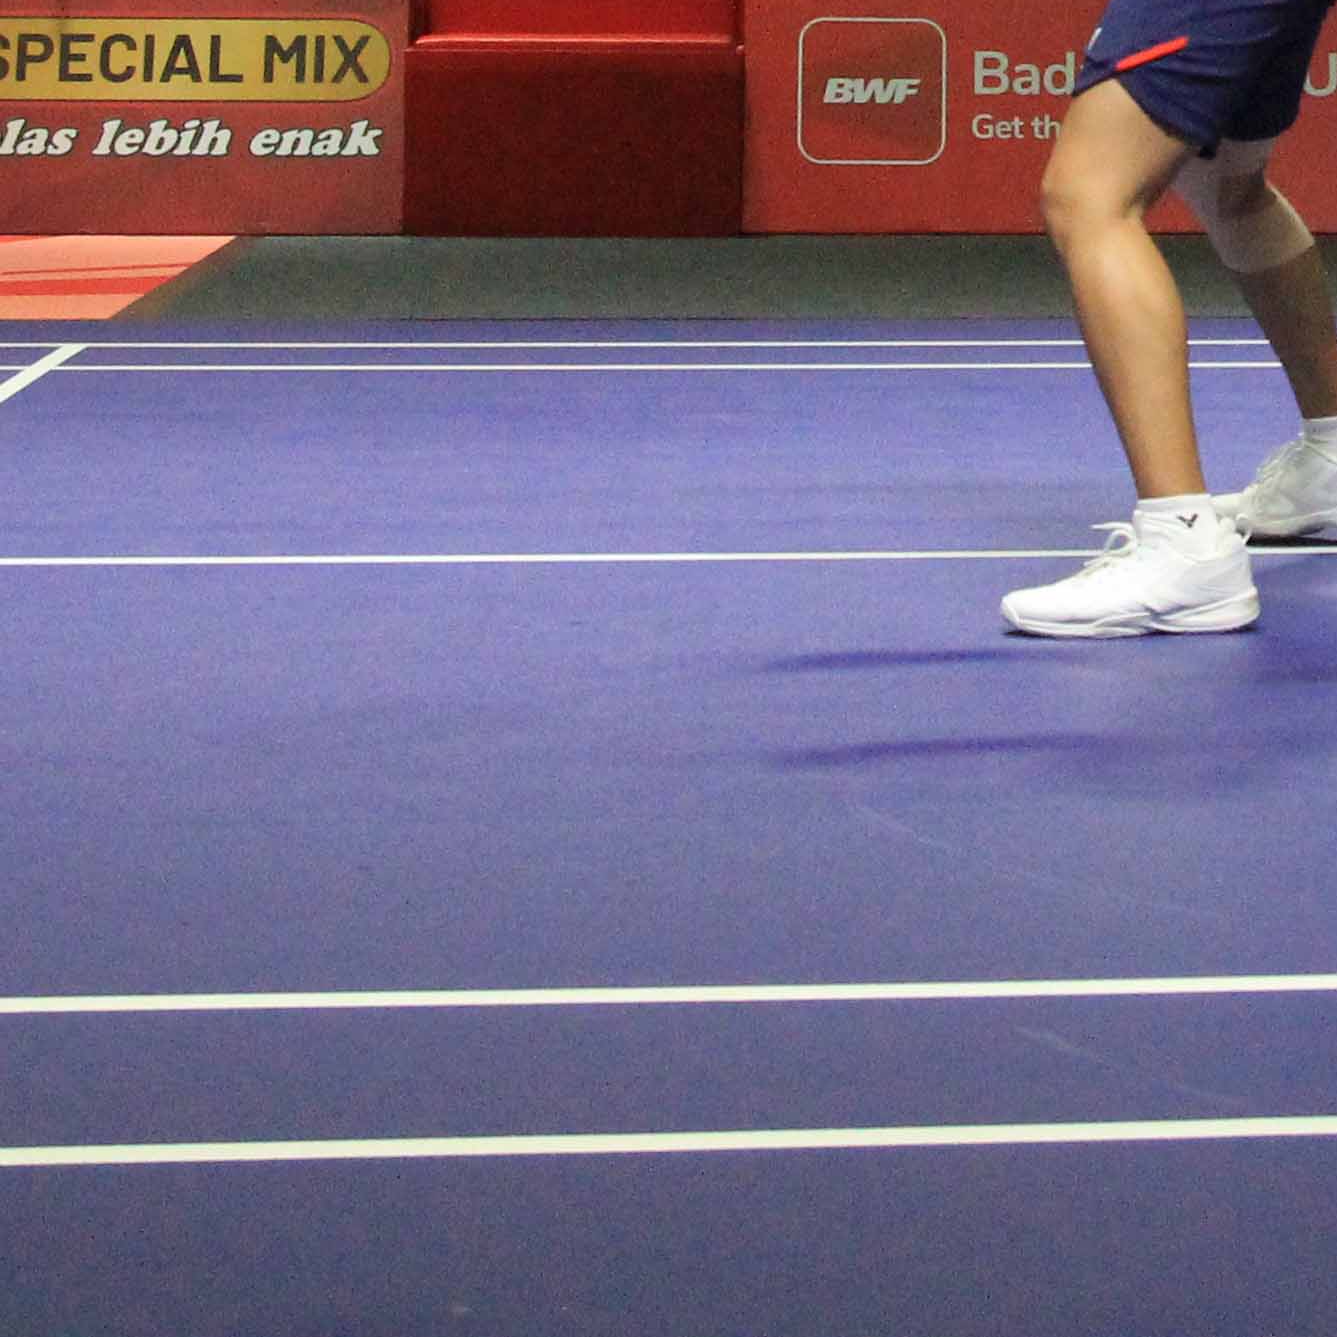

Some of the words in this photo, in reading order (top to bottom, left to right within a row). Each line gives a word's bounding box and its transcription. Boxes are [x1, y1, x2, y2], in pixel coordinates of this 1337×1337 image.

[0, 32, 244, 84] PECIAL
[262, 33, 372, 85] MIX
[822, 77, 921, 105] BWF
[0, 118, 79, 158] las
[91, 118, 236, 158] lebih
[248, 118, 384, 158] enak
[971, 114, 1025, 140] Get
[1029, 114, 1061, 140] th
